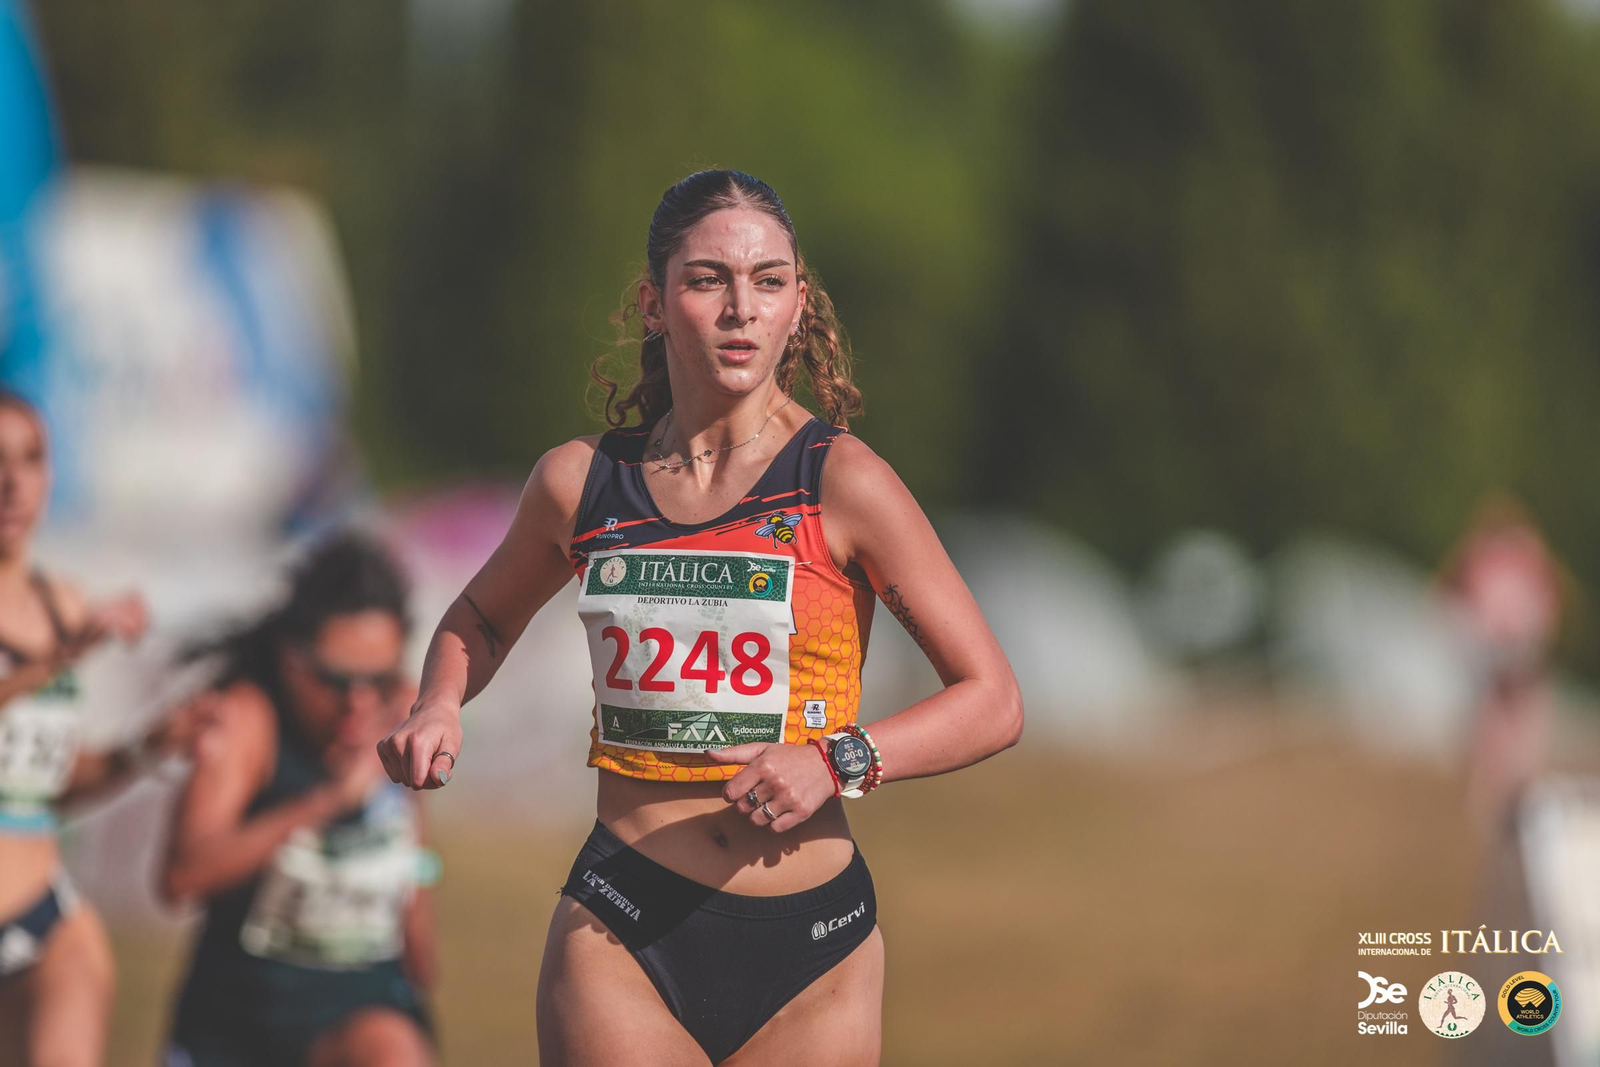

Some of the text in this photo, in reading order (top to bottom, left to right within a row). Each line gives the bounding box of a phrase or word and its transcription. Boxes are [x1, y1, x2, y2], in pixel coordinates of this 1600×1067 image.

[639, 557, 734, 584] ITÁLICA
[638, 581, 685, 589] INTERNATIONAL
[637, 596, 728, 608] DEPORTIVO LA ZUBIA
[601, 625, 774, 696] 2248
[740, 725, 774, 734] docunova
[828, 901, 865, 932] Cervi
